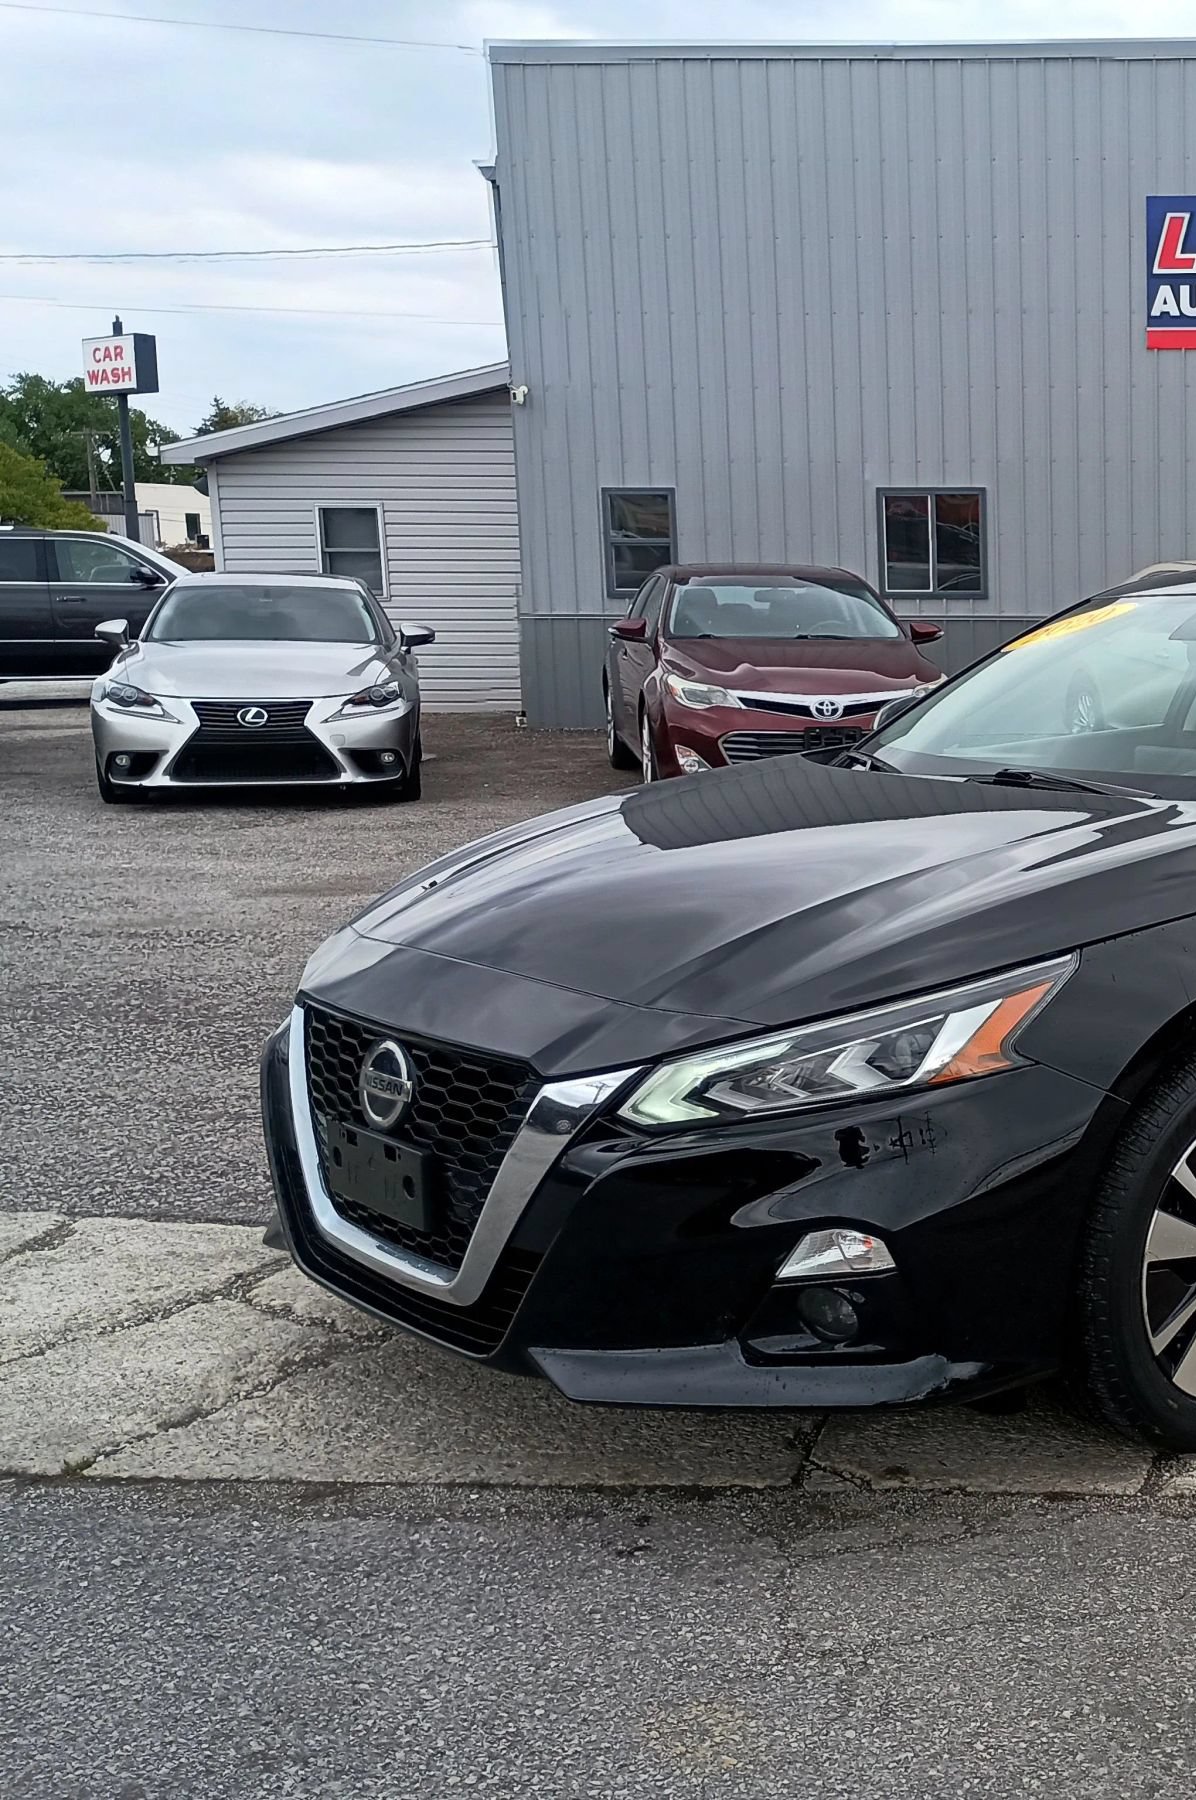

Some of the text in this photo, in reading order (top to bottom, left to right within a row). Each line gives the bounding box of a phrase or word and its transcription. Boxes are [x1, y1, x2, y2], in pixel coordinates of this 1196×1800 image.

[92, 345, 124, 364] CAR
[86, 366, 132, 386] WASH
[364, 1072, 403, 1097] NISSAN
